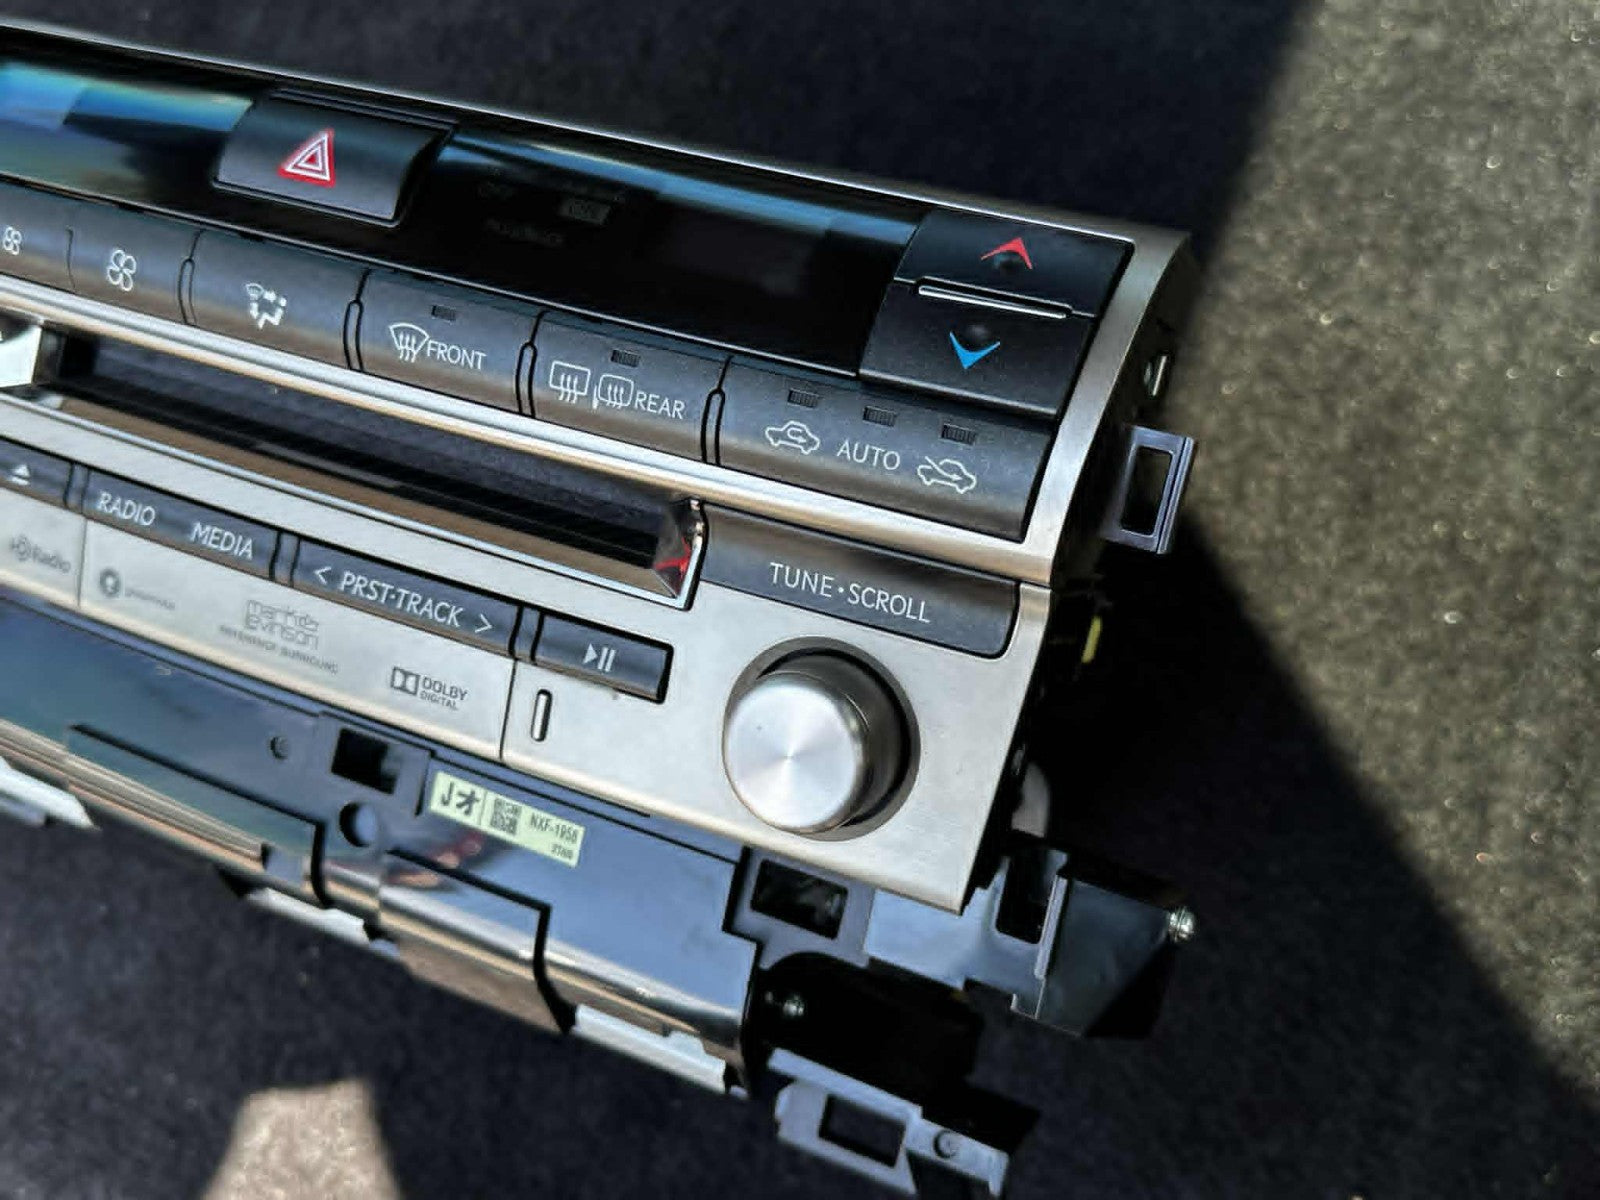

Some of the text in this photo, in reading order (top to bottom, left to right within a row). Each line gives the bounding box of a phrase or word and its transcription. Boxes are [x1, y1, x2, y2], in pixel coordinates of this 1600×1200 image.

[425, 339, 488, 371] FRONT
[634, 389, 687, 420] REAR
[836, 439, 901, 471] AUTO
[97, 490, 156, 527] RADIO
[189, 522, 254, 561] MEDIA
[419, 689, 459, 711] DIGITAL
[421, 676, 468, 701] DOLBY
